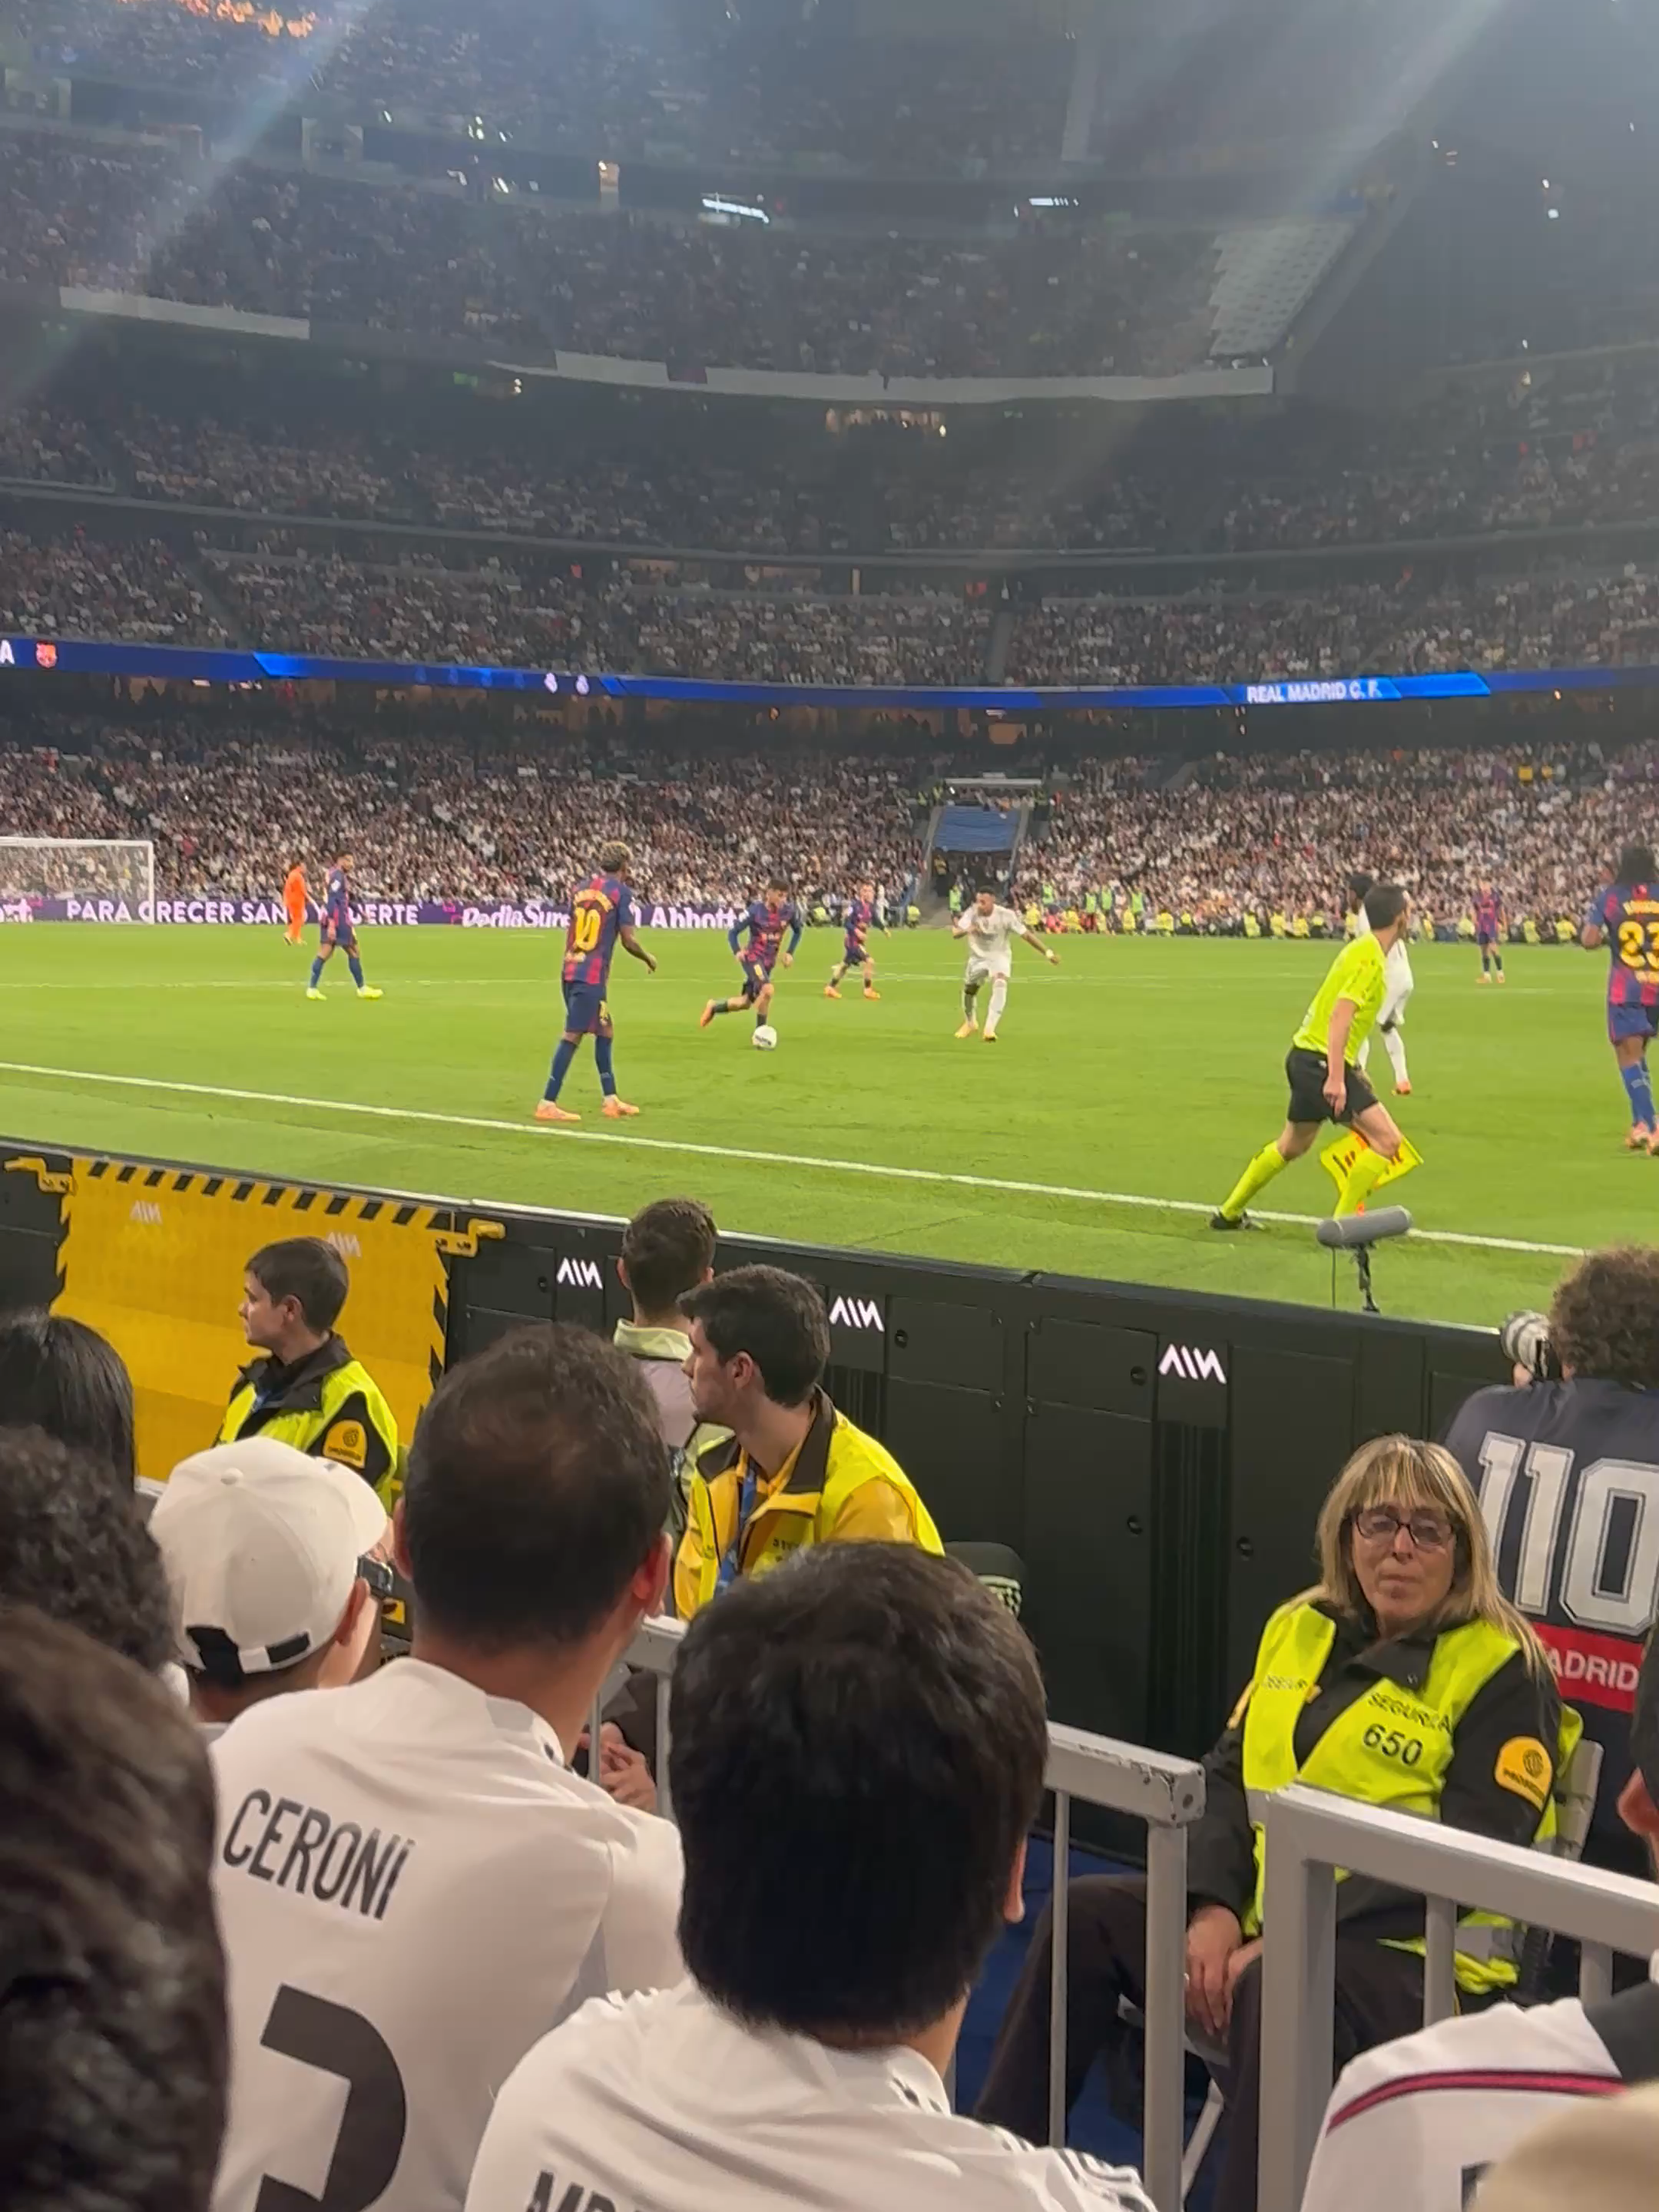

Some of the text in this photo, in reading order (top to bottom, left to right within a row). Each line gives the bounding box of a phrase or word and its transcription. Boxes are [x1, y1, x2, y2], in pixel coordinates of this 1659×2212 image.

[1247, 685, 1285, 704] REAL
[1287, 682, 1346, 701] MADRID
[67, 900, 132, 922] PARA
[138, 901, 235, 923] CRECER
[241, 902, 307, 925] SAN
[350, 904, 419, 925] UERTE
[575, 907, 601, 951] 10
[650, 906, 736, 929] Abbott
[1478, 1431, 1659, 1636] 110
[1547, 1647, 1640, 1691] ADRID
[1363, 1723, 1422, 1766] 650
[223, 1789, 416, 1920] CERONI
